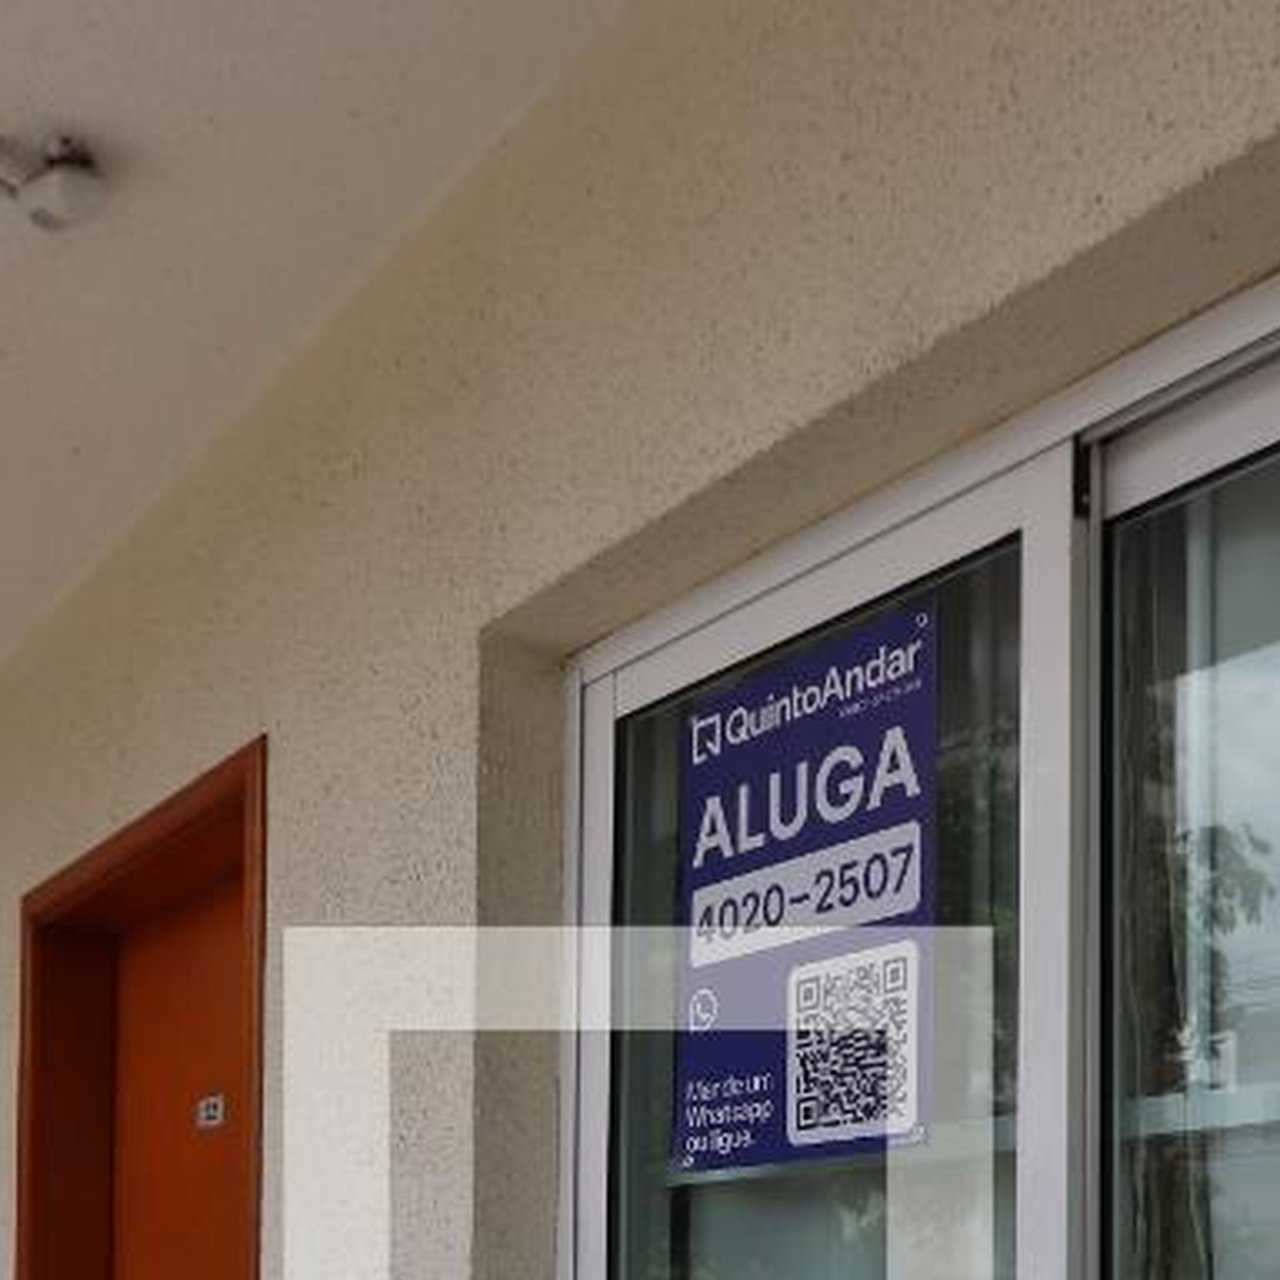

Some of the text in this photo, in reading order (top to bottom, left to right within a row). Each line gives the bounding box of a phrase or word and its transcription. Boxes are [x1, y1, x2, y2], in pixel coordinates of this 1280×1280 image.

[725, 640, 921, 745] QuintoAndar
[693, 725, 920, 869] ALUGA
[696, 844, 914, 943] 4020-2507
